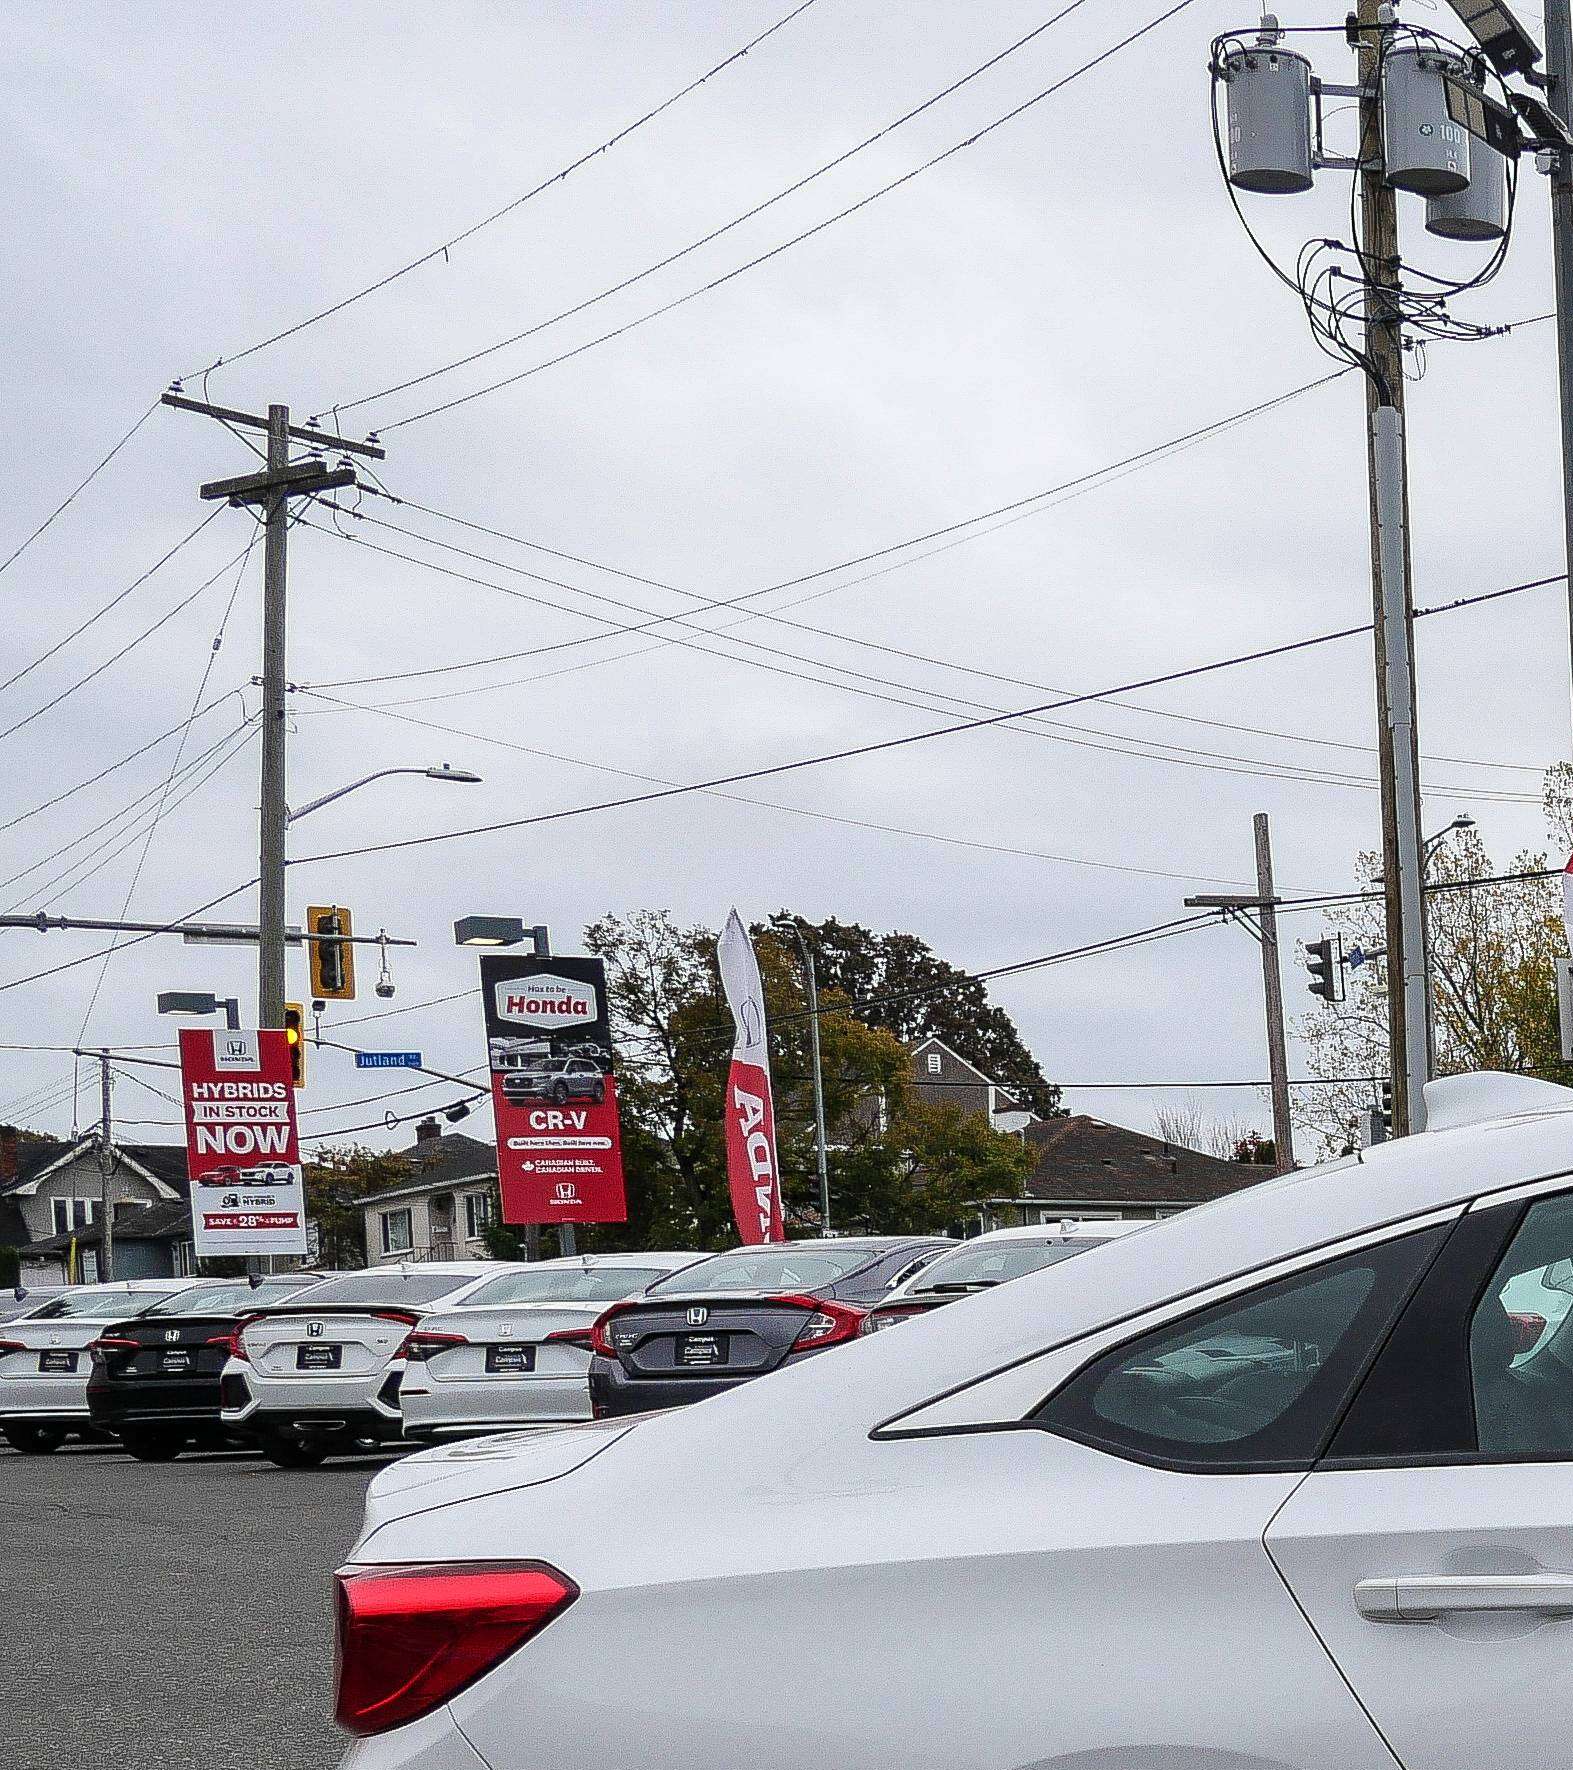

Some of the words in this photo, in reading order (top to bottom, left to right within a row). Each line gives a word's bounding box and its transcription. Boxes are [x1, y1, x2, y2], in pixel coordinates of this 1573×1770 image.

[506, 995, 588, 1016] Honda
[360, 1054, 405, 1066] Jutland
[192, 1082, 287, 1099] HYBRIDS
[203, 1106, 219, 1118] IN
[225, 1105, 280, 1118] STOCK
[529, 1110, 587, 1130] CR-V
[196, 1125, 290, 1154] NOW
